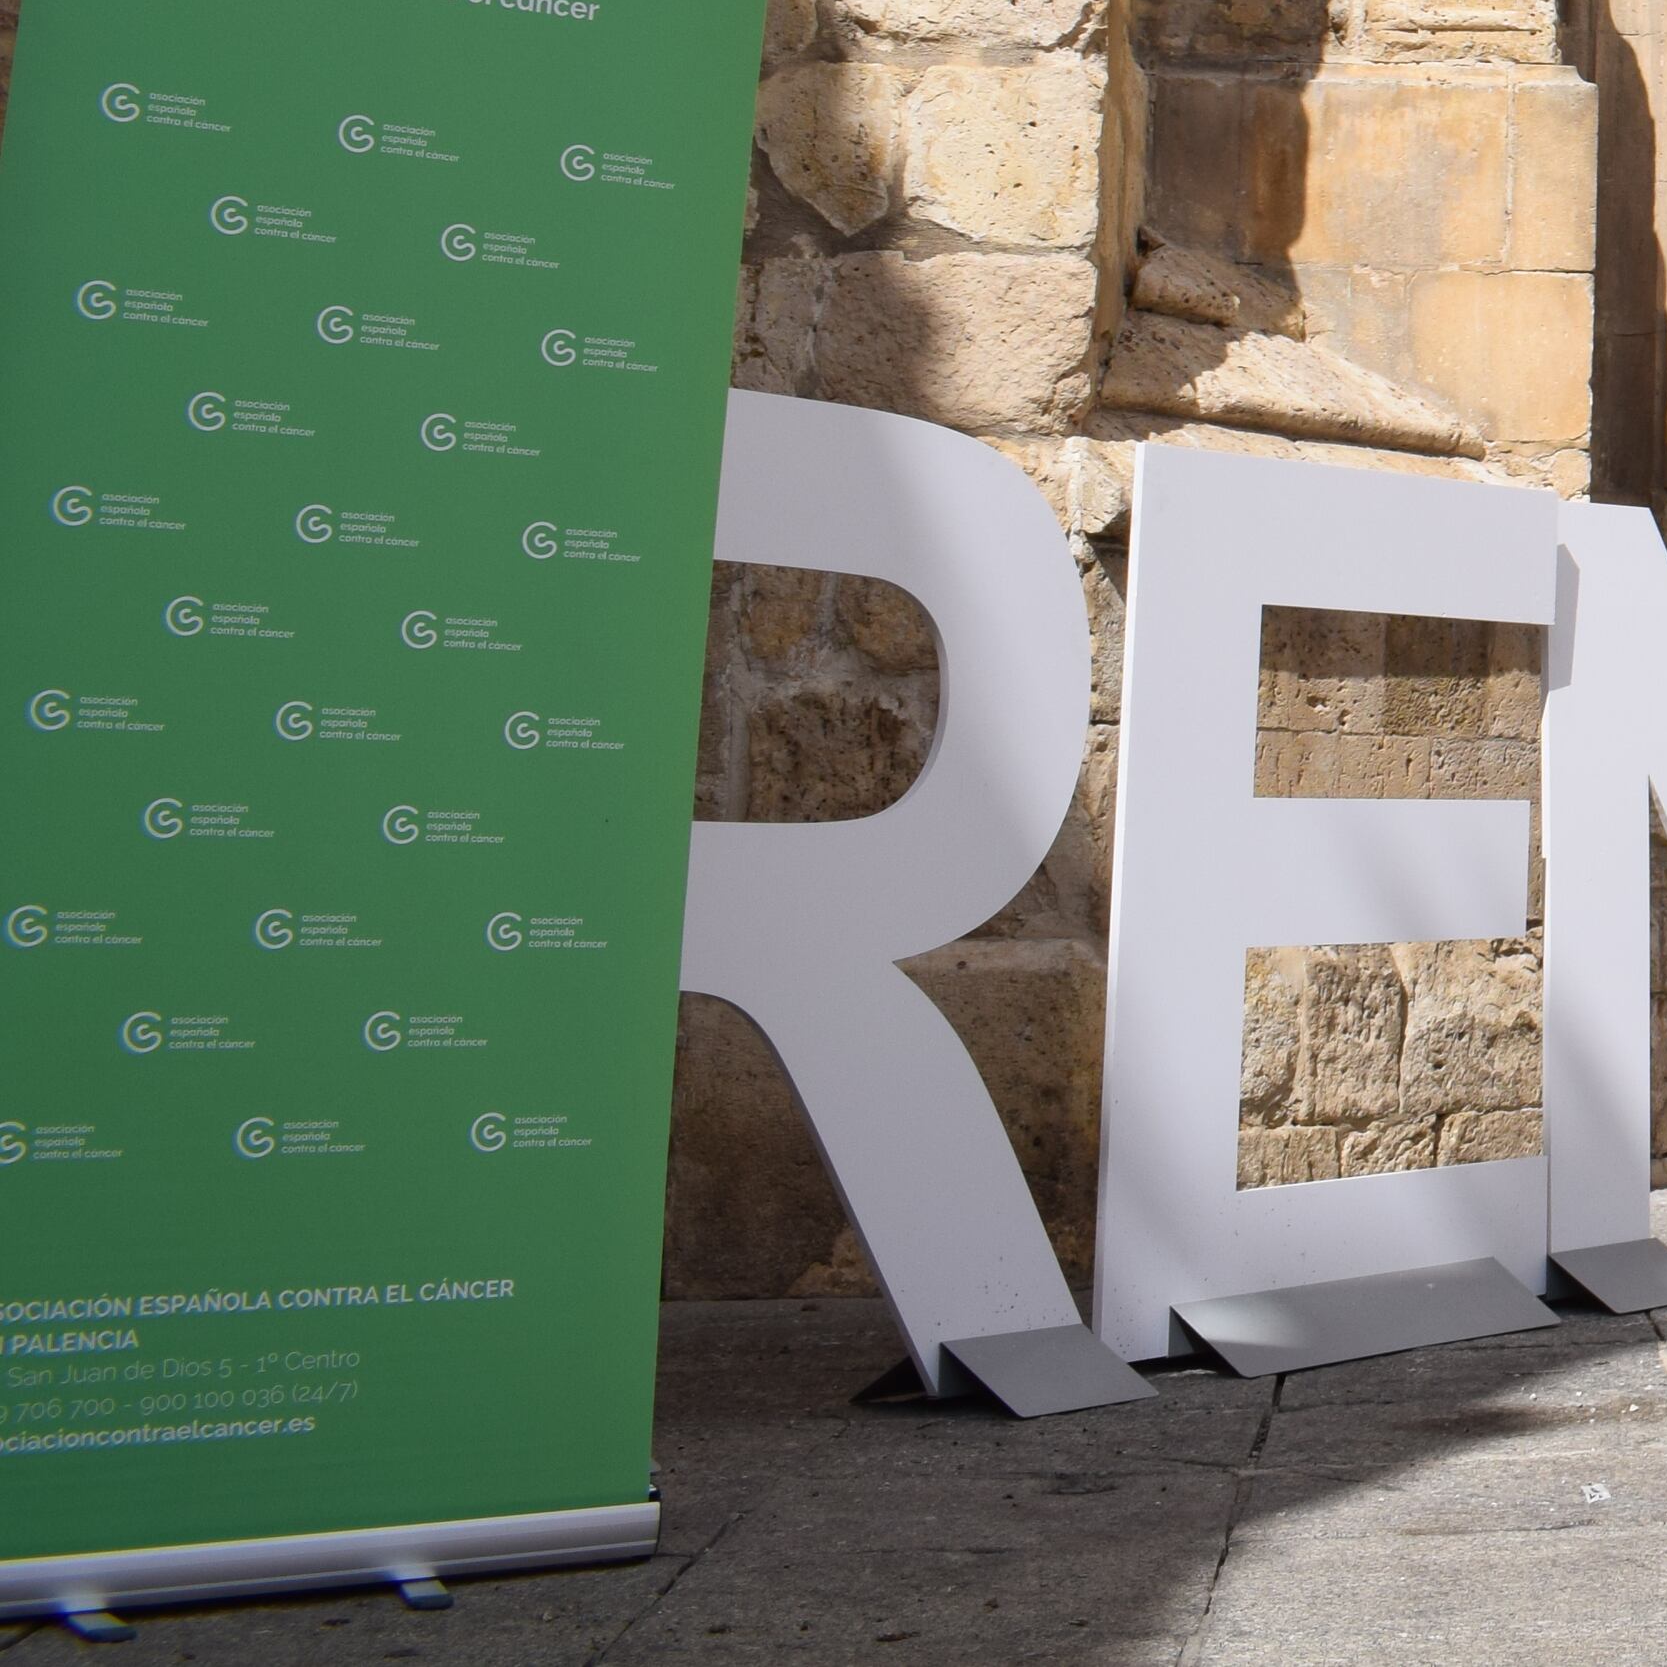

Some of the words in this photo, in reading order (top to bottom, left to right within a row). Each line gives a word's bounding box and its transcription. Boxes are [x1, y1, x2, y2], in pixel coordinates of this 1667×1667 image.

[149, 93, 206, 106] asociación
[148, 104, 198, 116] española
[147, 115, 183, 126] contra
[184, 118, 195, 127] el
[383, 124, 436, 136] asociación
[382, 135, 428, 147] española
[381, 145, 415, 156] contra
[416, 149, 426, 158] el
[603, 153, 652, 165] asociación
[602, 164, 645, 175] española
[600, 174, 632, 184] contra
[634, 177, 644, 185] el
[257, 205, 312, 217] asociación
[256, 216, 303, 228] española
[254, 228, 290, 237] contra
[291, 230, 301, 239] el
[126, 289, 183, 301] asociación
[124, 300, 173, 311] española
[123, 311, 160, 322] contra
[161, 314, 172, 323] el
[362, 314, 415, 326] asociación
[361, 325, 407, 336] española
[360, 335, 393, 346] contra
[395, 338, 405, 347] el
[235, 400, 290, 411] asociación
[234, 411, 282, 422] española
[232, 421, 268, 432] contra
[269, 425, 280, 433] el
[341, 511, 395, 522] asociación
[340, 523, 386, 533] española
[339, 535, 374, 543] contra
[375, 535, 384, 544] el
[445, 617, 498, 627] asociación
[444, 628, 489, 638] española
[443, 637, 476, 648] contra
[478, 640, 487, 649] el
[548, 716, 600, 726] asociación
[547, 728, 592, 738] española
[546, 739, 578, 748] contra
[581, 739, 591, 749] el
[302, 913, 358, 922] asociación
[530, 916, 584, 925] asociación
[301, 925, 350, 935] española
[529, 927, 576, 938] española
[299, 938, 334, 946] contra
[336, 937, 347, 946] el
[528, 939, 561, 948] contra
[563, 939, 574, 948] el
[410, 1014, 463, 1023] asociación
[409, 1025, 455, 1037] española
[408, 1038, 440, 1047] contra
[443, 1037, 453, 1046] el
[0, 1293, 132, 1322] OCIACIÓN
[139, 1288, 272, 1316] ESPAÑOLA
[278, 1285, 379, 1309] CONTRA
[385, 1284, 414, 1303] EL
[419, 1277, 515, 1302] CÁNCER
[12, 1329, 140, 1355] PALENCIA
[8, 1366, 52, 1388] San
[60, 1364, 117, 1384] Juan
[124, 1360, 155, 1380] de
[163, 1358, 212, 1378] Dios
[218, 1358, 232, 1378] 5
[285, 1350, 360, 1371] Centro
[16, 1398, 62, 1423] 706
[71, 1398, 116, 1419] 700
[140, 1394, 187, 1416] 900
[193, 1390, 234, 1409] 100
[242, 1385, 285, 1408] 036
[292, 1380, 359, 1404] (24/7)
